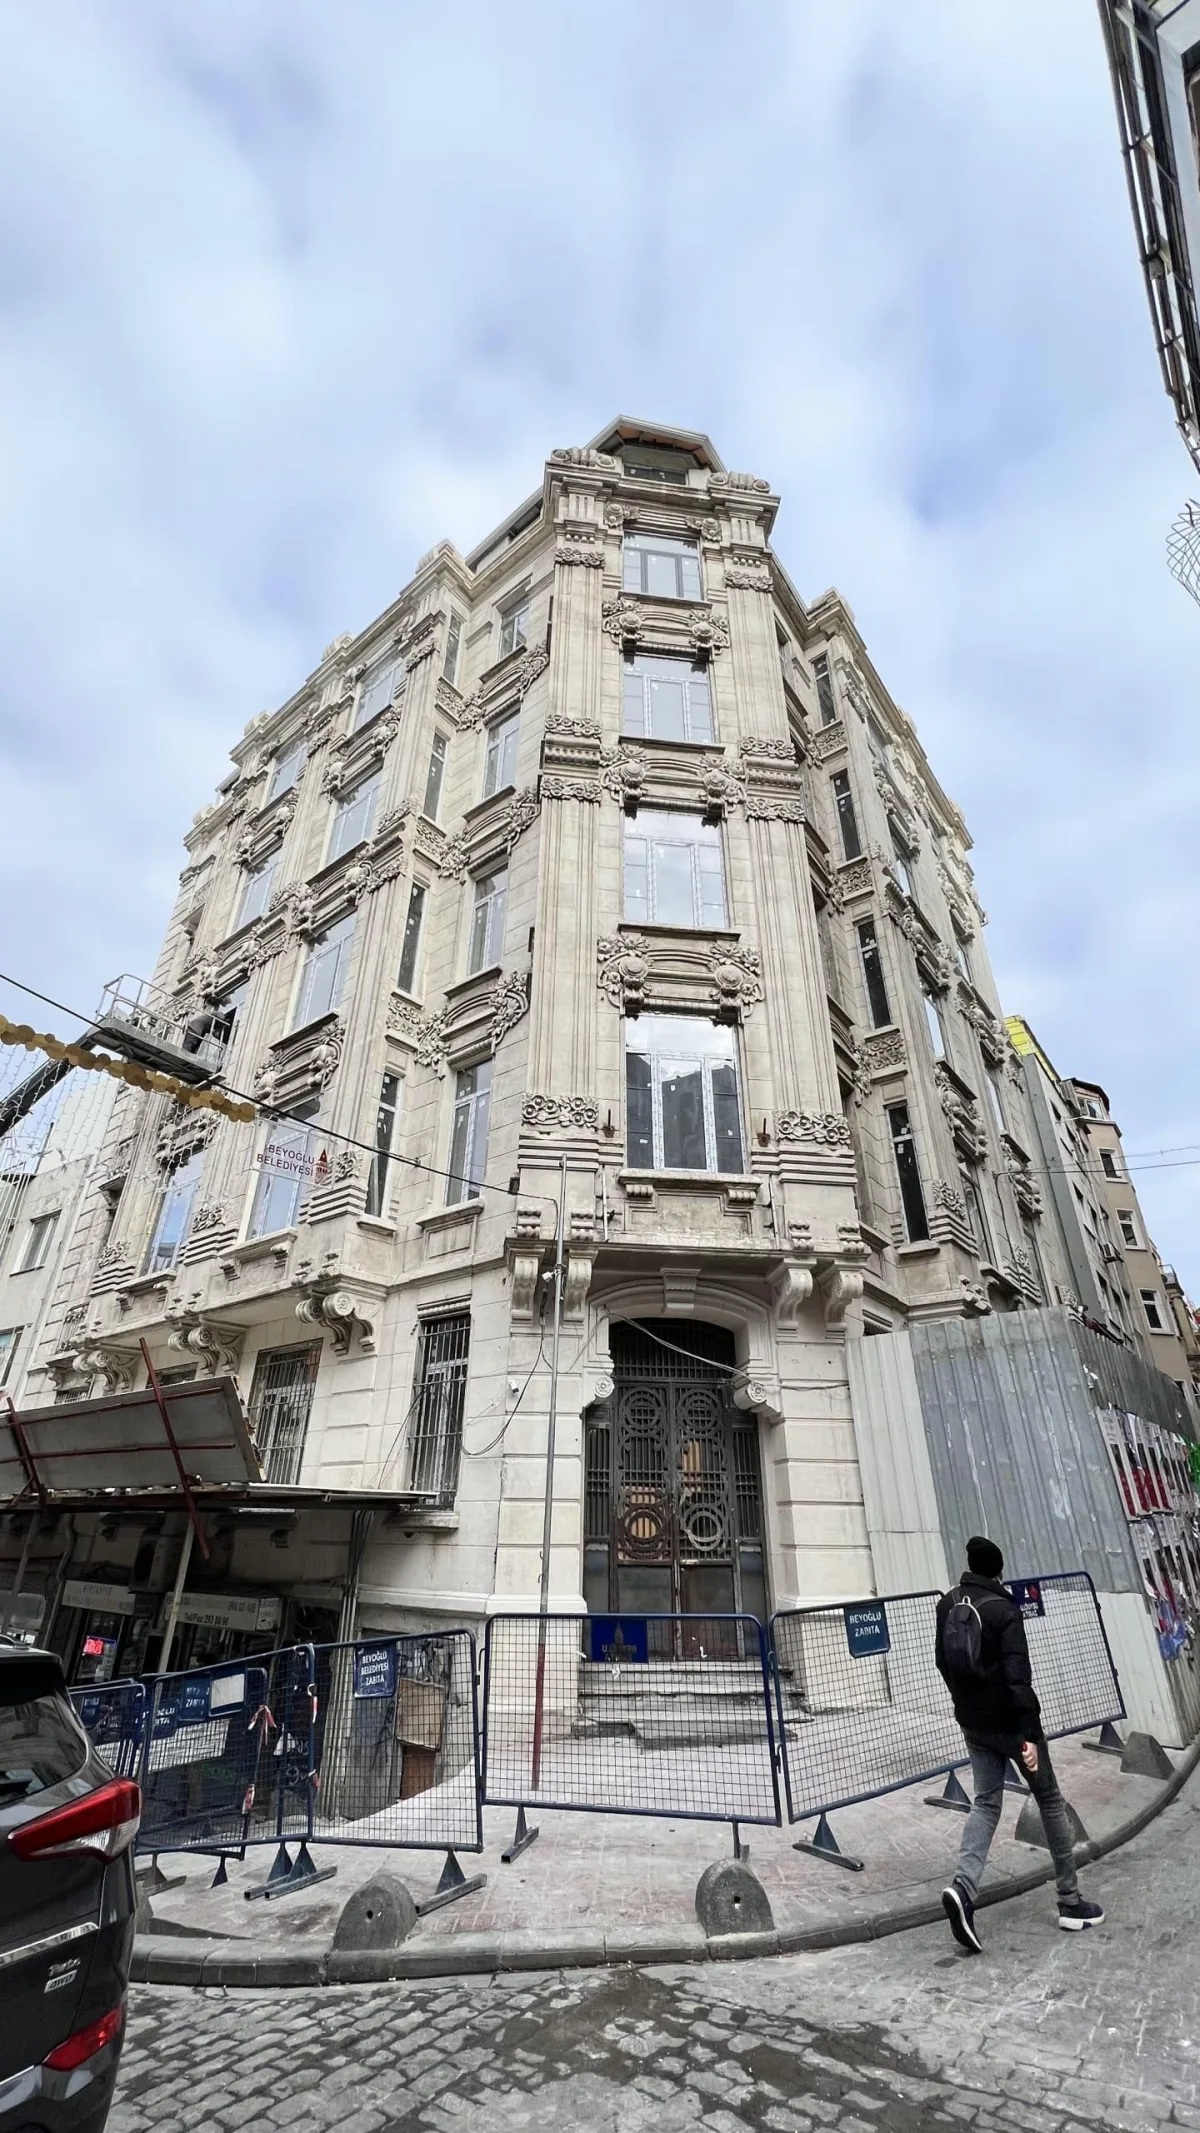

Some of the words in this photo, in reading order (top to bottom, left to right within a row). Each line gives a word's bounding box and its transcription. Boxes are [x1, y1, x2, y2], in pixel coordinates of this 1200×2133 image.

[268, 1144, 315, 1164] BEYOĞLU
[849, 1610, 882, 1624] BEYOĞLU
[854, 1624, 881, 1638] ZABITA
[362, 1650, 388, 1664] BEYOĞLU
[365, 1674, 385, 1686] ZABITA
